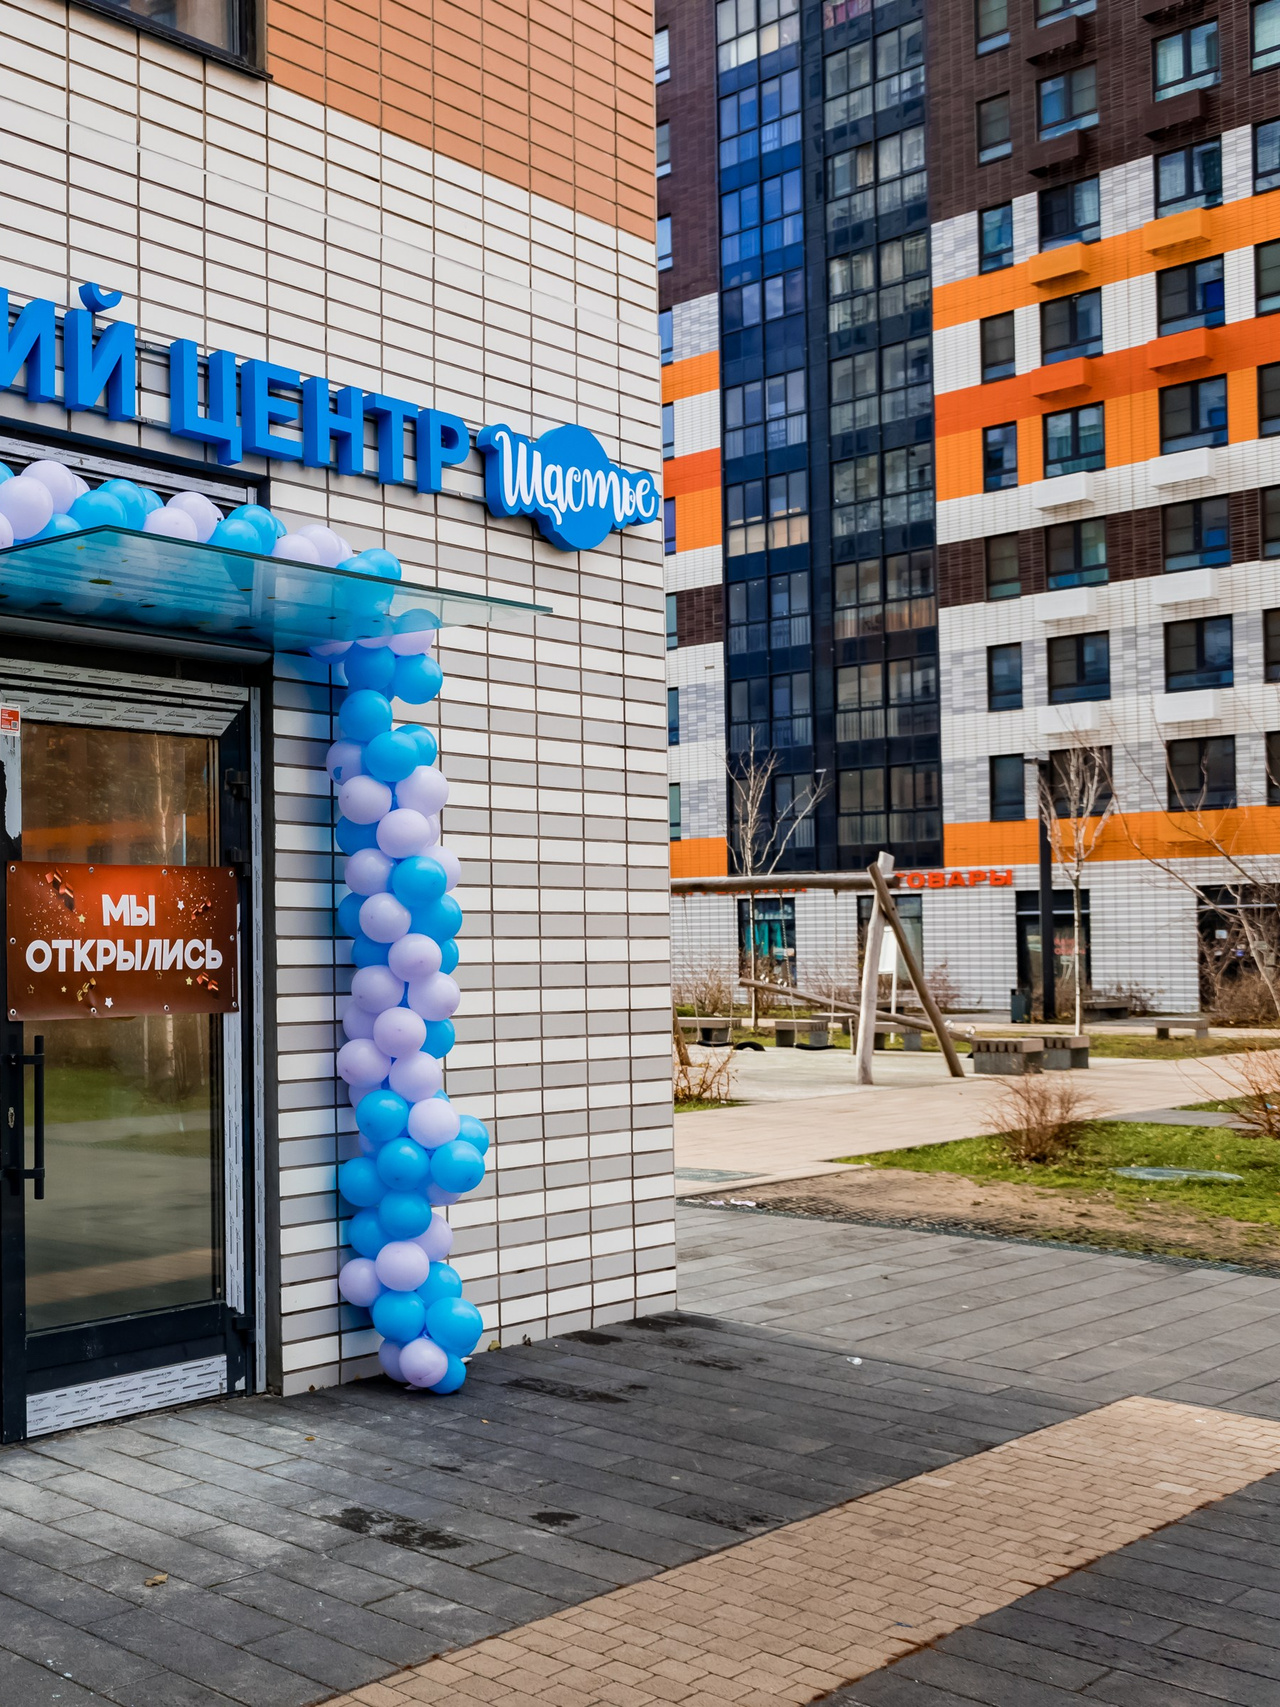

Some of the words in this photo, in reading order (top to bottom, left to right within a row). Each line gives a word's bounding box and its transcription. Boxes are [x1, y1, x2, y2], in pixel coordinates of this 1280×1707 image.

[169, 338, 470, 494] ЦЕНТР
[101, 894, 156, 927] МЫ
[25, 938, 223, 973] ОТКРЫЛИСЬ
